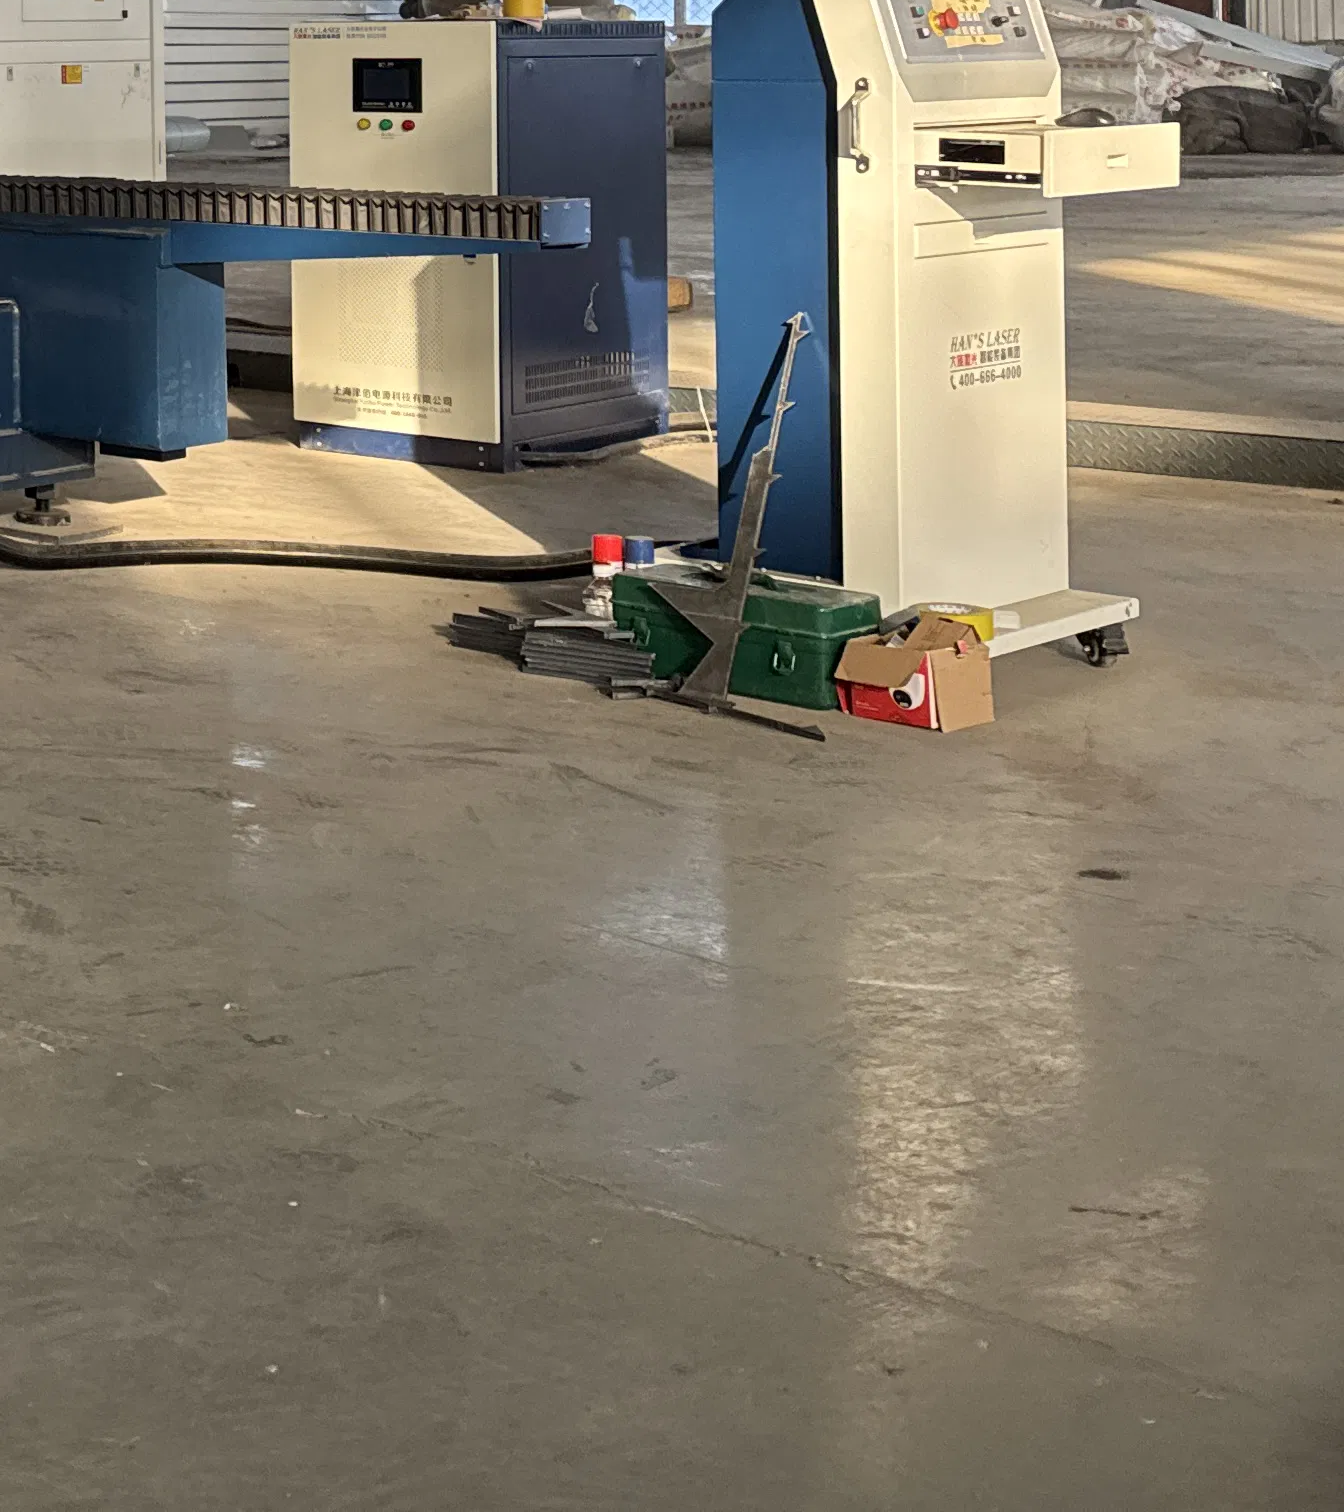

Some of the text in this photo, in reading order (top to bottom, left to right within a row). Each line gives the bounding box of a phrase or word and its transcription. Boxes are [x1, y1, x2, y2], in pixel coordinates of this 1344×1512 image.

[950, 327, 1021, 353] HAN'S LASER
[958, 364, 1022, 387] 400-666-4000
